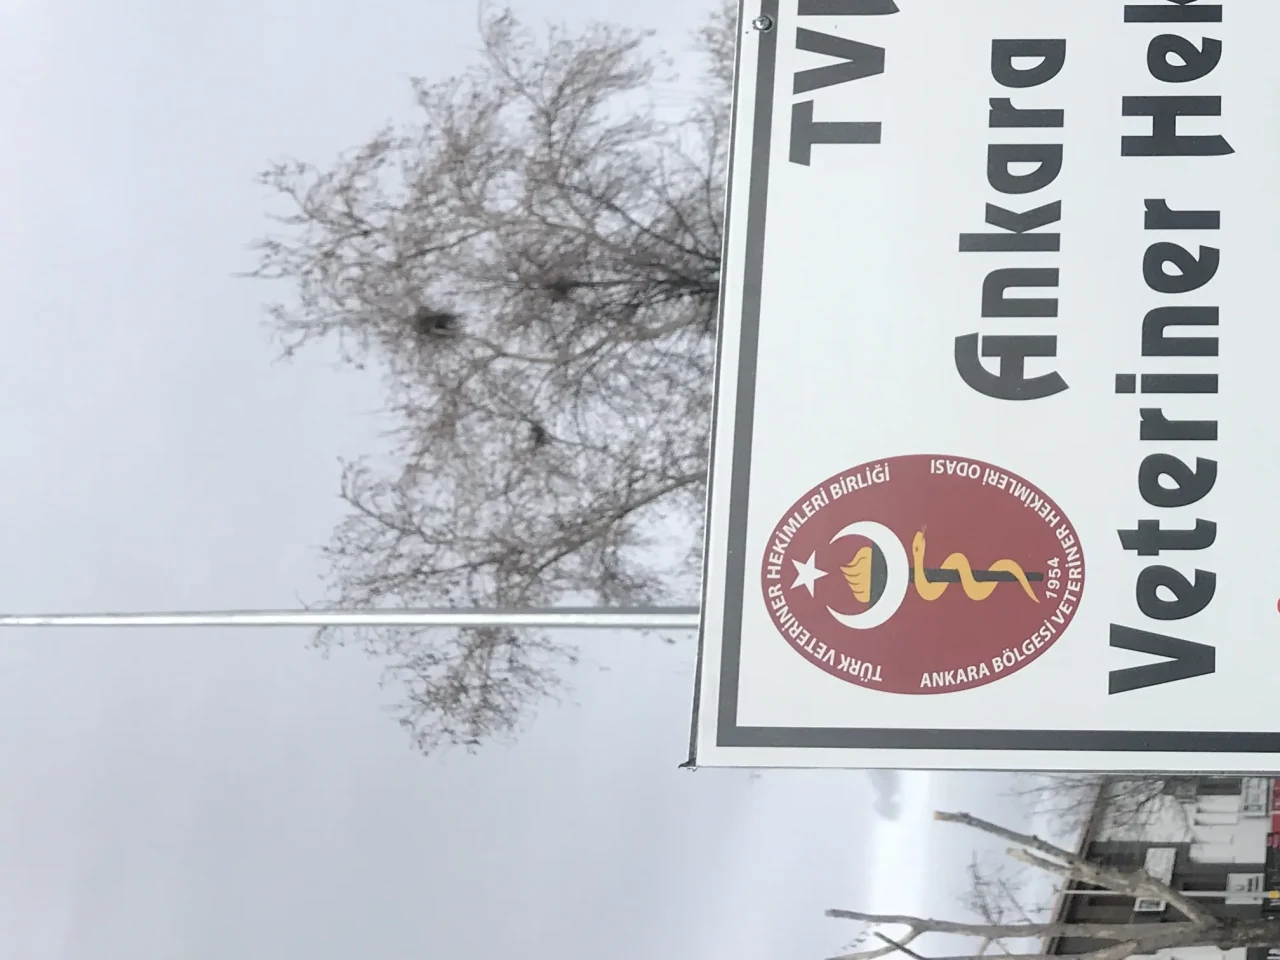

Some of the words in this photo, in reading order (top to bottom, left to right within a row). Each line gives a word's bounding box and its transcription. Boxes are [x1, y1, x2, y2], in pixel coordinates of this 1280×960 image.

[955, 39, 1068, 400] Ankara
[930, 459, 981, 479] ODASI
[1108, 199, 1220, 695] Veteriner
[828, 462, 891, 500] BİRLİĞİ
[982, 467, 1061, 526] HEKİMLERİ
[766, 486, 830, 579] HEKİMLERİ
[1045, 556, 1061, 599] 1954
[1050, 523, 1082, 625] VETERİNER
[767, 584, 837, 666] VETERİNER
[990, 620, 1057, 672] BÖLGESİ
[835, 654, 882, 681] TÜRK
[919, 663, 991, 688] ANKARA
